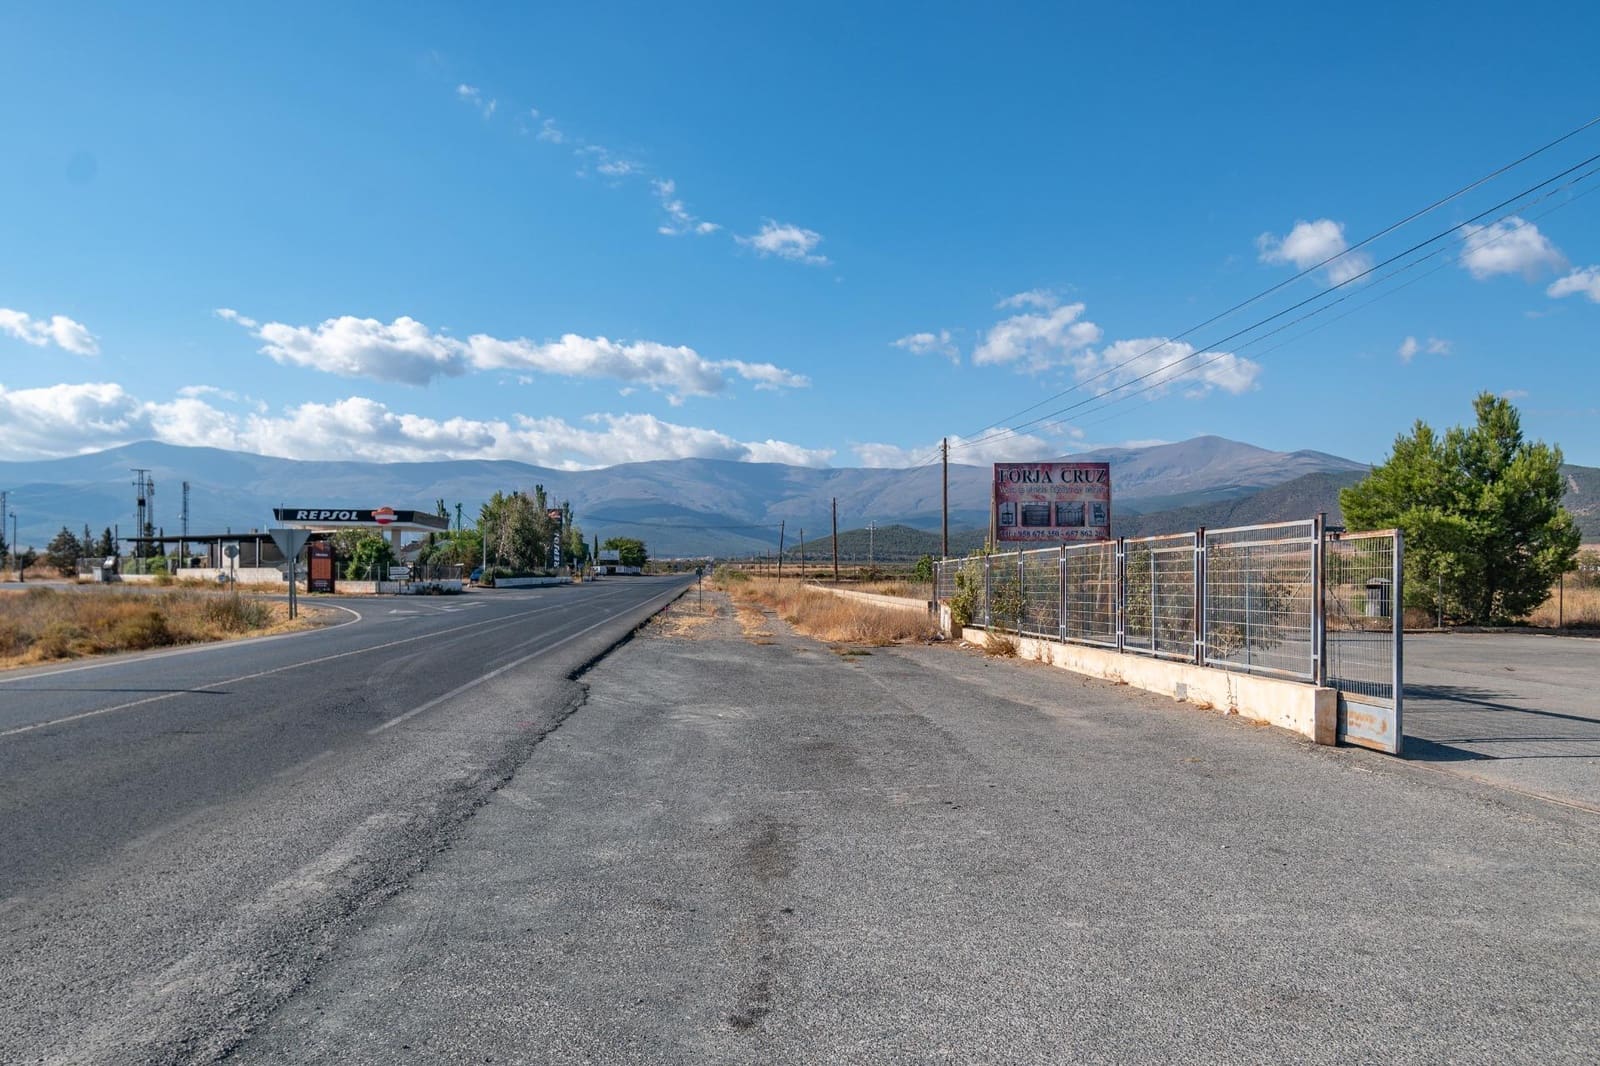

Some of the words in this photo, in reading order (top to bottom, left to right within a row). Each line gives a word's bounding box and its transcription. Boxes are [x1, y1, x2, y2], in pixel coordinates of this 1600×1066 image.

[999, 469, 1053, 484] FORJA
[1061, 469, 1105, 484] CRUZ
[296, 510, 359, 520] REPSOL
